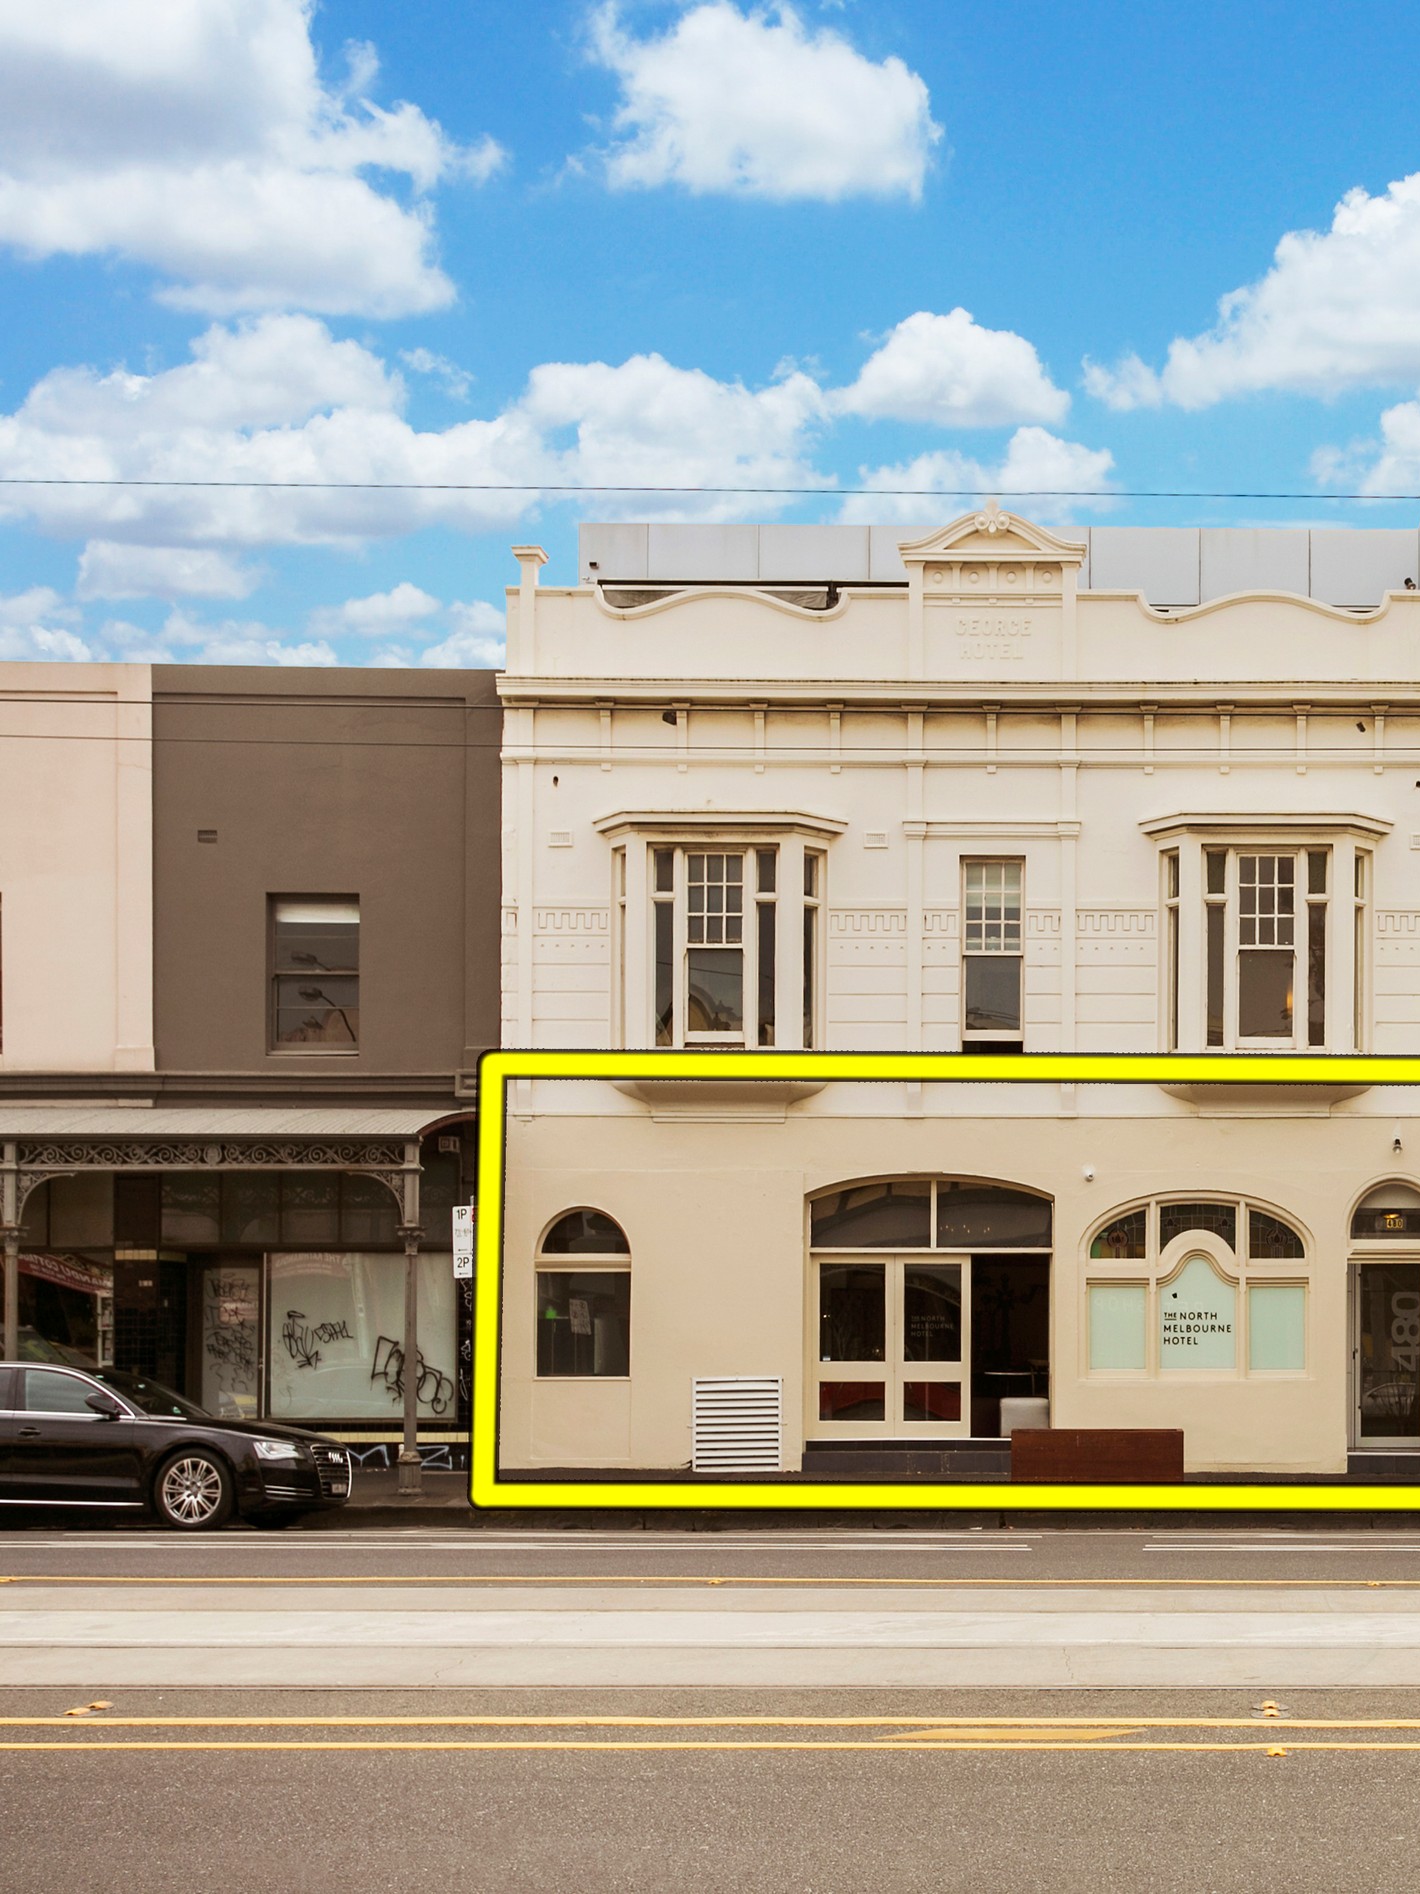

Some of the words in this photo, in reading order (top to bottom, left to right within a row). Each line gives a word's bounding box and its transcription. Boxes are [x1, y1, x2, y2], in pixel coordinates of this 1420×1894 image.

[955, 618, 1032, 637] GEORGE
[960, 642, 1024, 660] HOTEL
[457, 1208, 467, 1220] 1P
[457, 1256, 470, 1268] 2P
[1179, 1312, 1218, 1320] NORTH
[1163, 1324, 1232, 1333] MELBOURNE
[1392, 1292, 1420, 1372] 480
[1163, 1336, 1198, 1345] HOTEL
